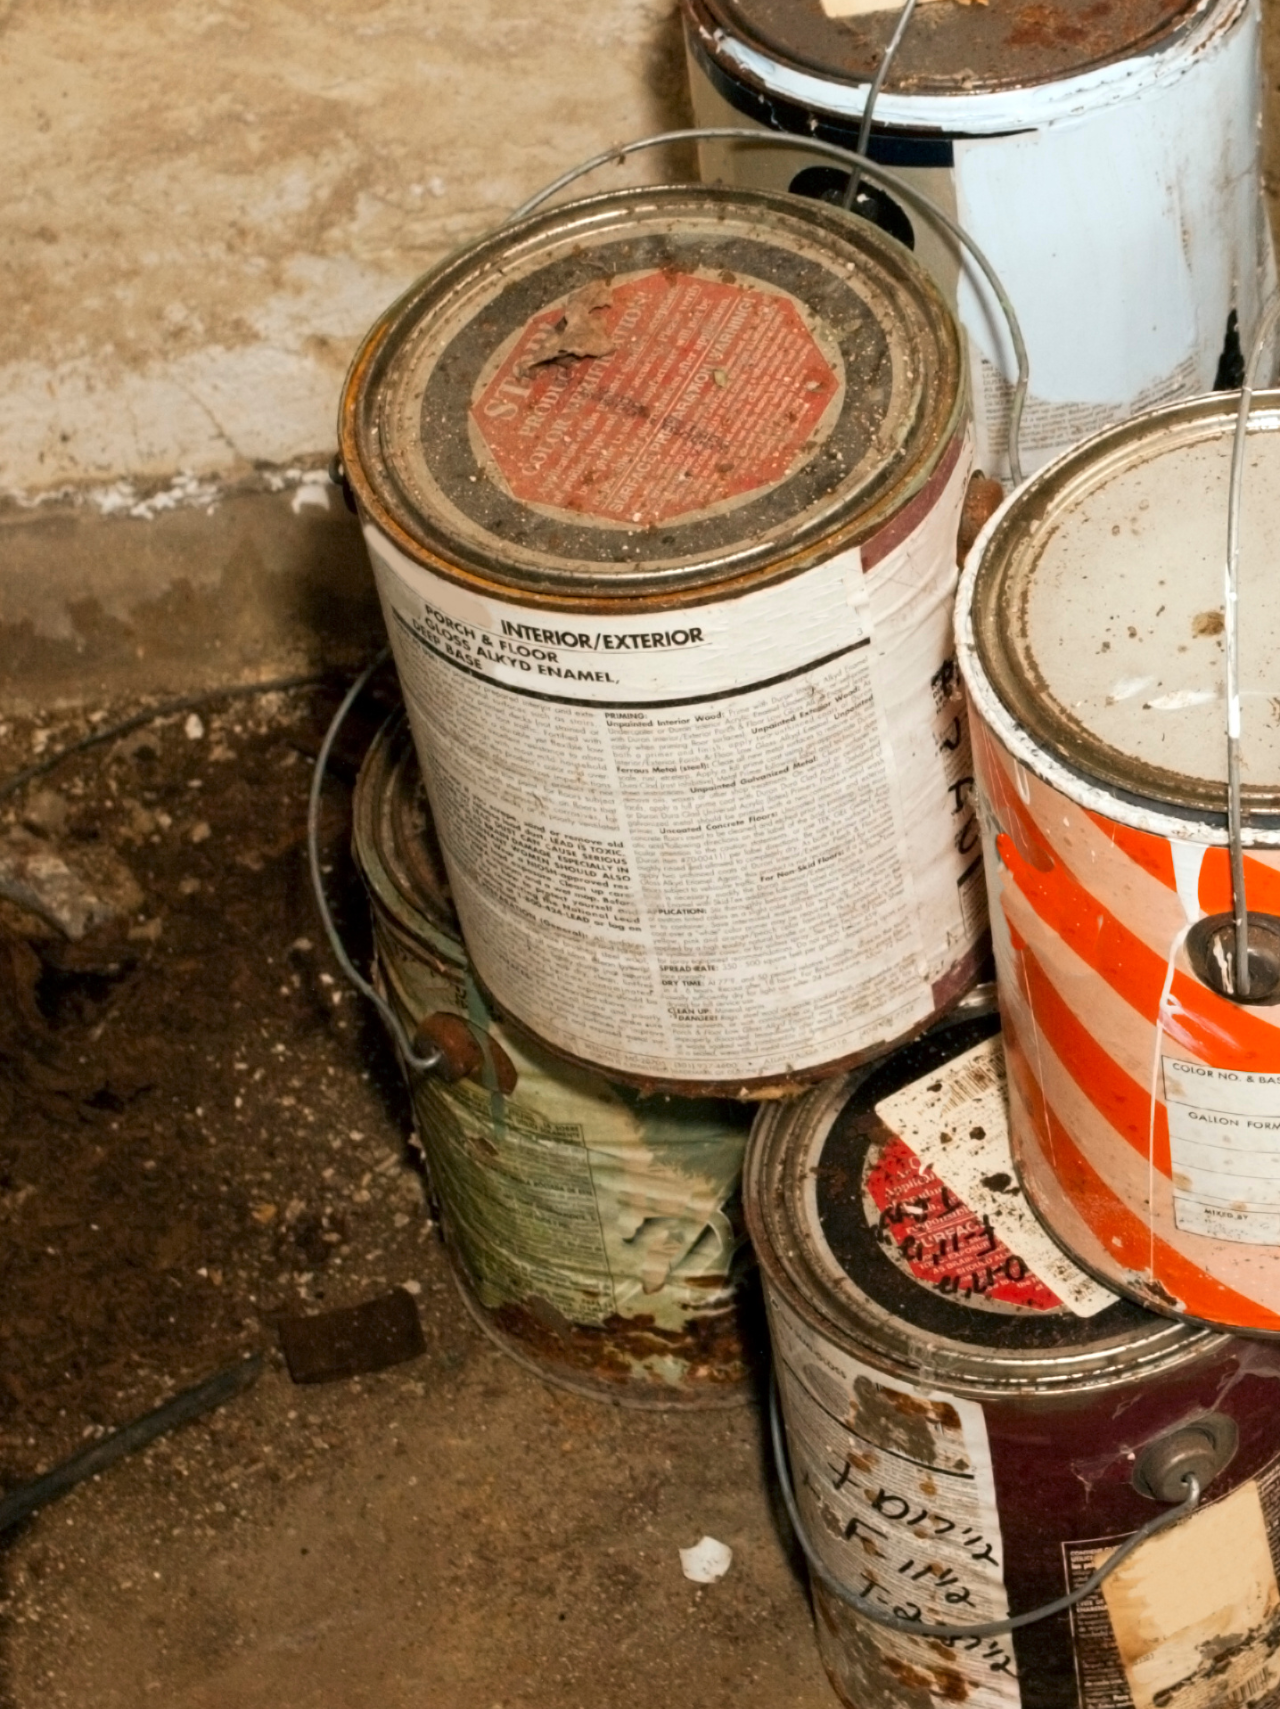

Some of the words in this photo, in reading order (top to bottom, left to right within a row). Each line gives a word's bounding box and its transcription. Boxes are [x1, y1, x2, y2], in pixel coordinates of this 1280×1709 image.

[674, 349, 697, 376] after
[584, 430, 606, 456] type
[608, 448, 658, 515] SURFACE
[425, 604, 476, 640] PORCH
[482, 634, 494, 646] &
[500, 640, 558, 662] FLOOR
[500, 619, 704, 650] INTERIOR/EXTERIOR
[412, 618, 441, 646] DEEP
[445, 643, 482, 670] BASE
[424, 617, 471, 651] GLOSS
[476, 646, 531, 672] ALKYD
[538, 664, 620, 684] ENAMEL,
[658, 717, 690, 725] Interior
[582, 853, 628, 865] SERIOUS
[591, 846, 626, 856] TOXIC.
[554, 862, 598, 877] SHOULD
[603, 873, 630, 882] ALSO
[558, 855, 612, 872] ESPECIALLY
[1172, 1062, 1214, 1078] COLOR
[1218, 1072, 1242, 1082] NO.
[1247, 1075, 1254, 1083] &
[1188, 1111, 1239, 1126] GALLON
[1204, 1208, 1234, 1218] MIXED
